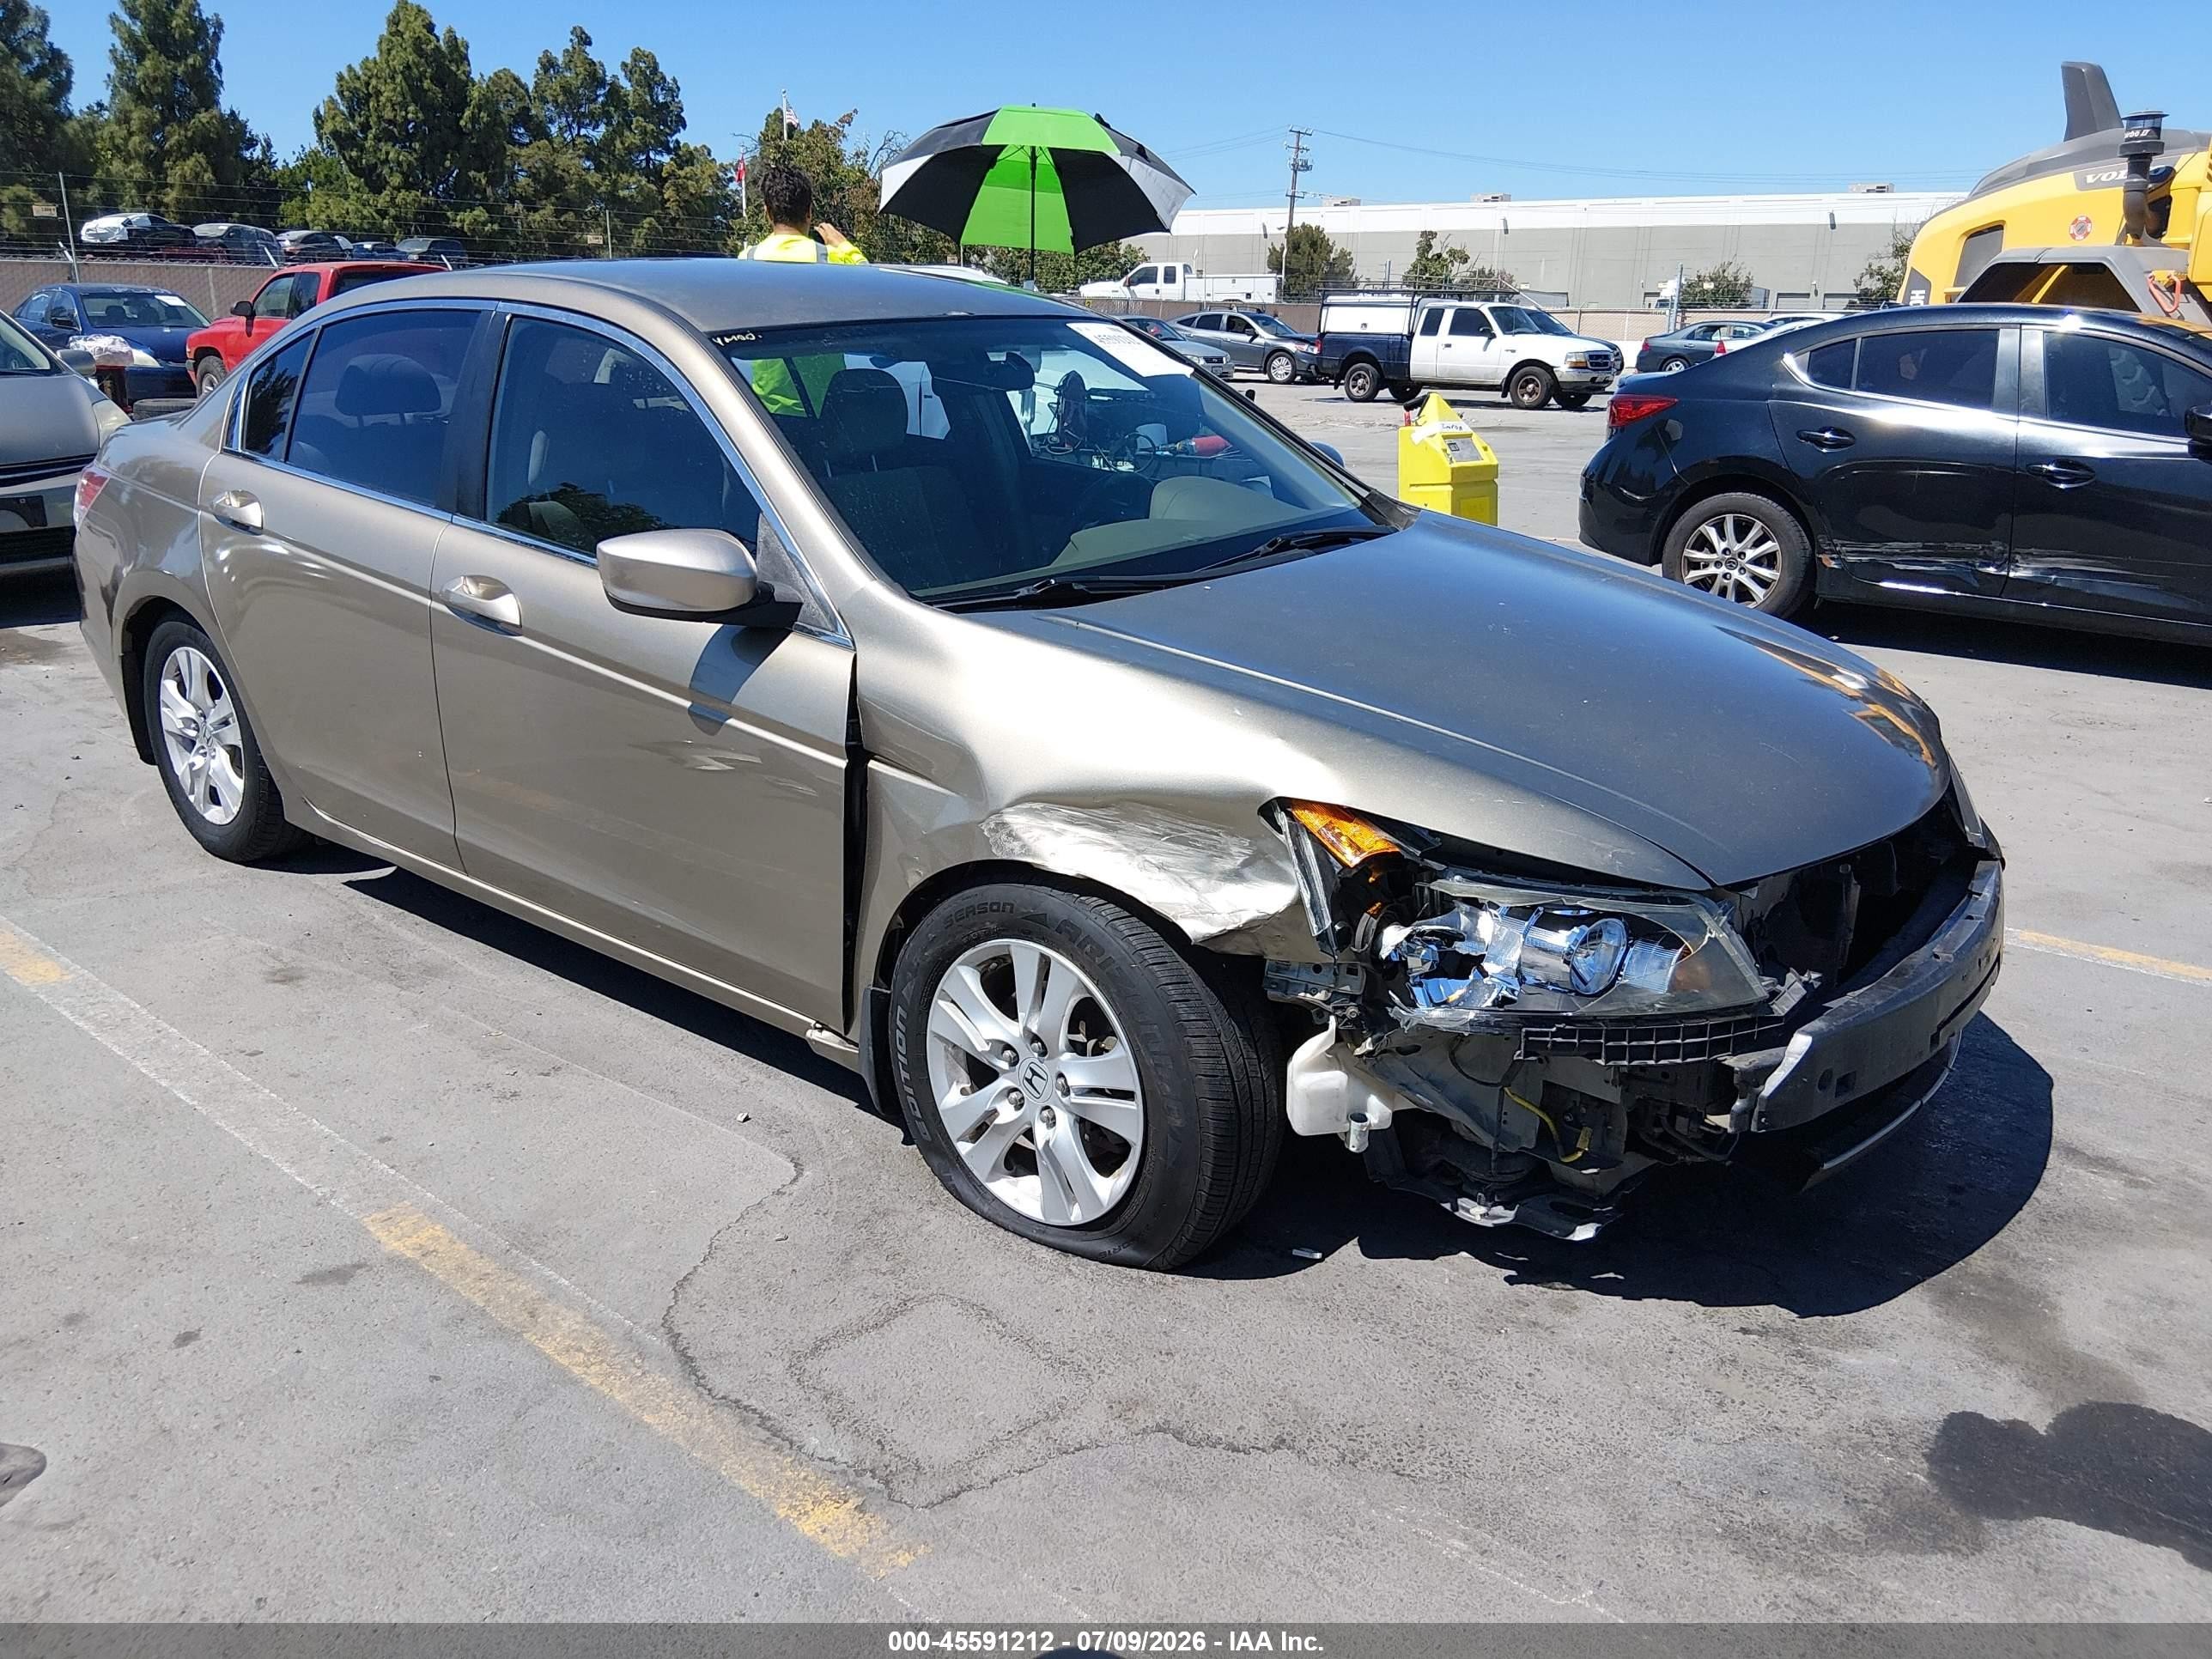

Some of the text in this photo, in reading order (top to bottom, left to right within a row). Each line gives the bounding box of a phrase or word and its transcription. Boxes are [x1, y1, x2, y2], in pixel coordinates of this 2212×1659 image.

[2086, 170, 2128, 184] VOL
[945, 902, 1015, 929] SEASON
[896, 1004, 933, 1142] EDITION
